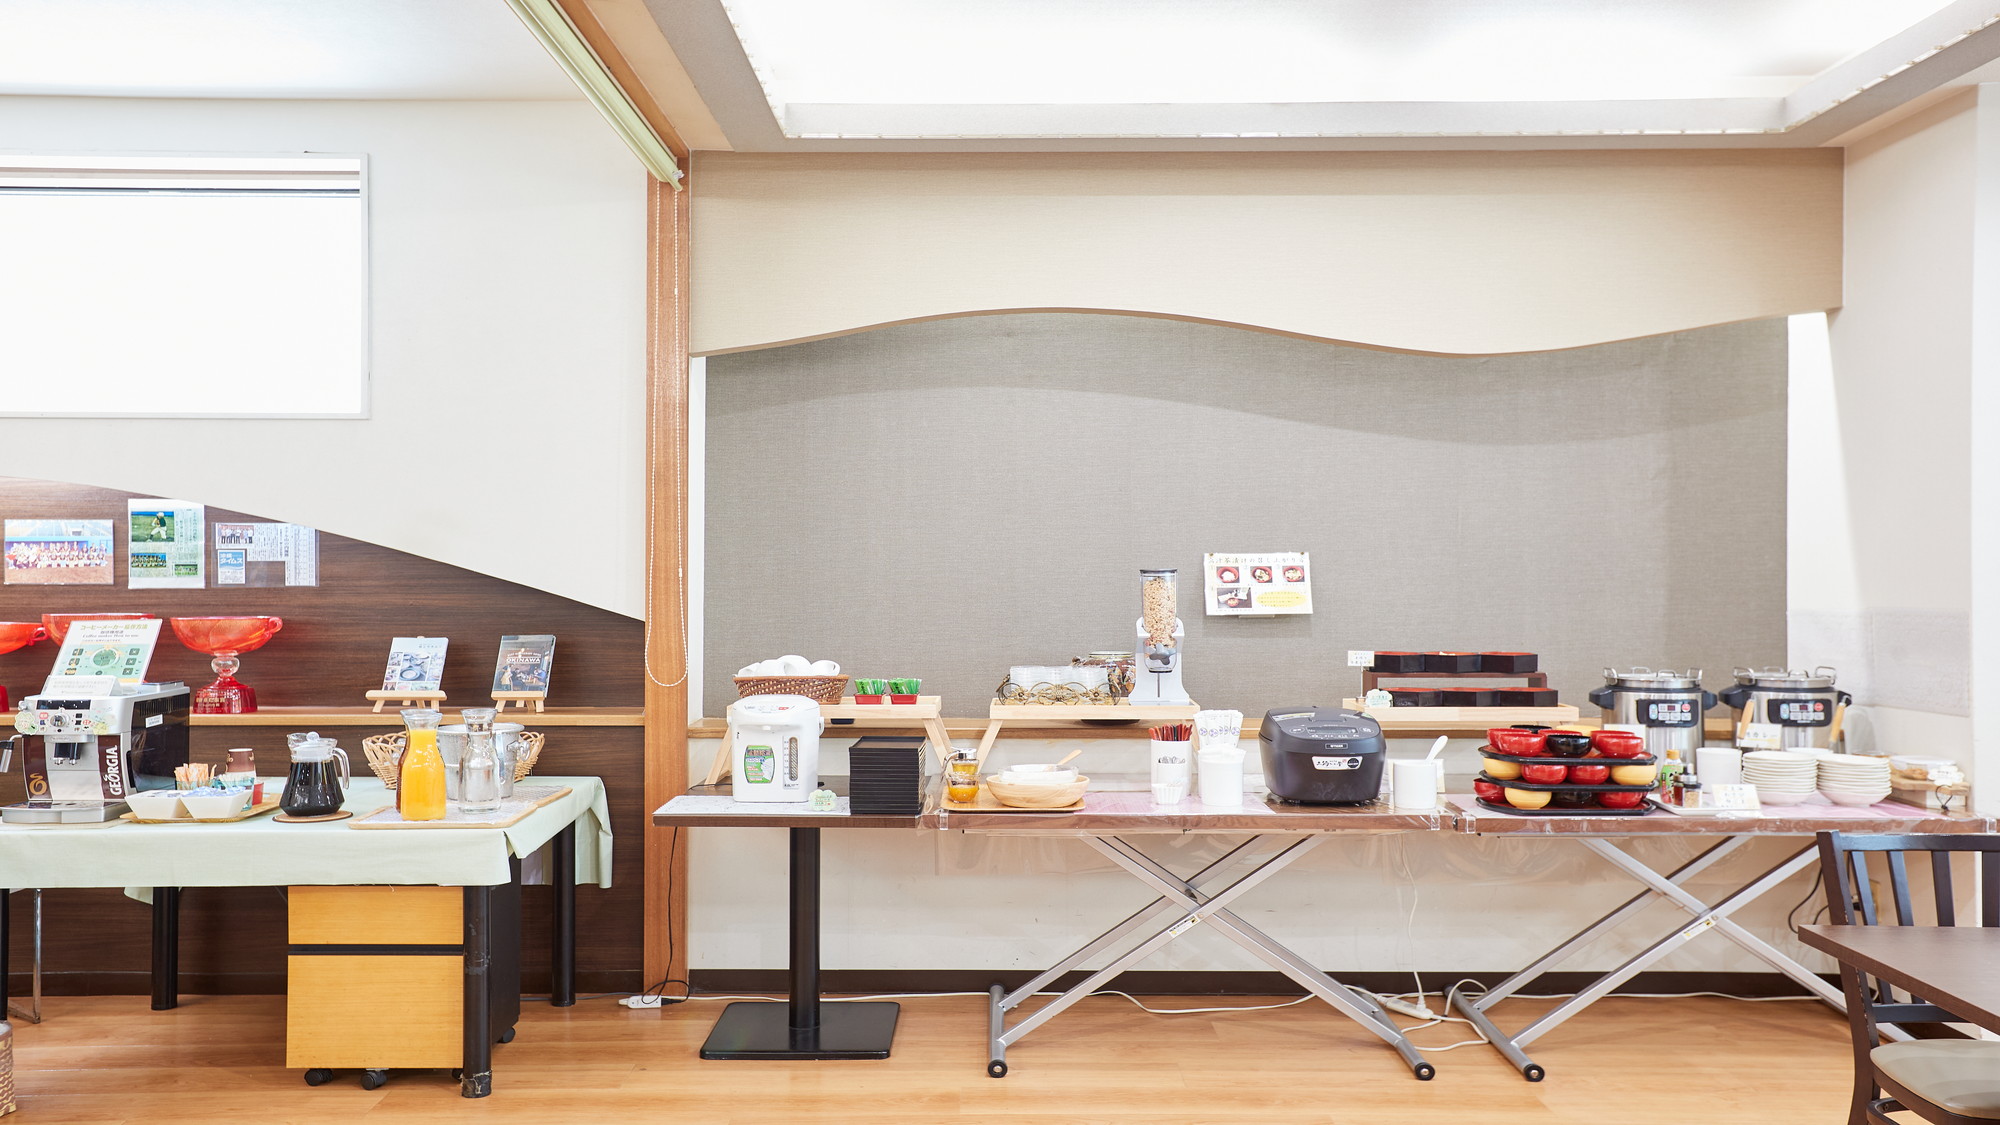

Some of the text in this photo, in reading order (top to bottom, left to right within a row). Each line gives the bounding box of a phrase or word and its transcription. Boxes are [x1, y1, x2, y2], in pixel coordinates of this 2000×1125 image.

[219, 557, 243, 565] タイムス
[105, 745, 122, 796] GEORGIA
